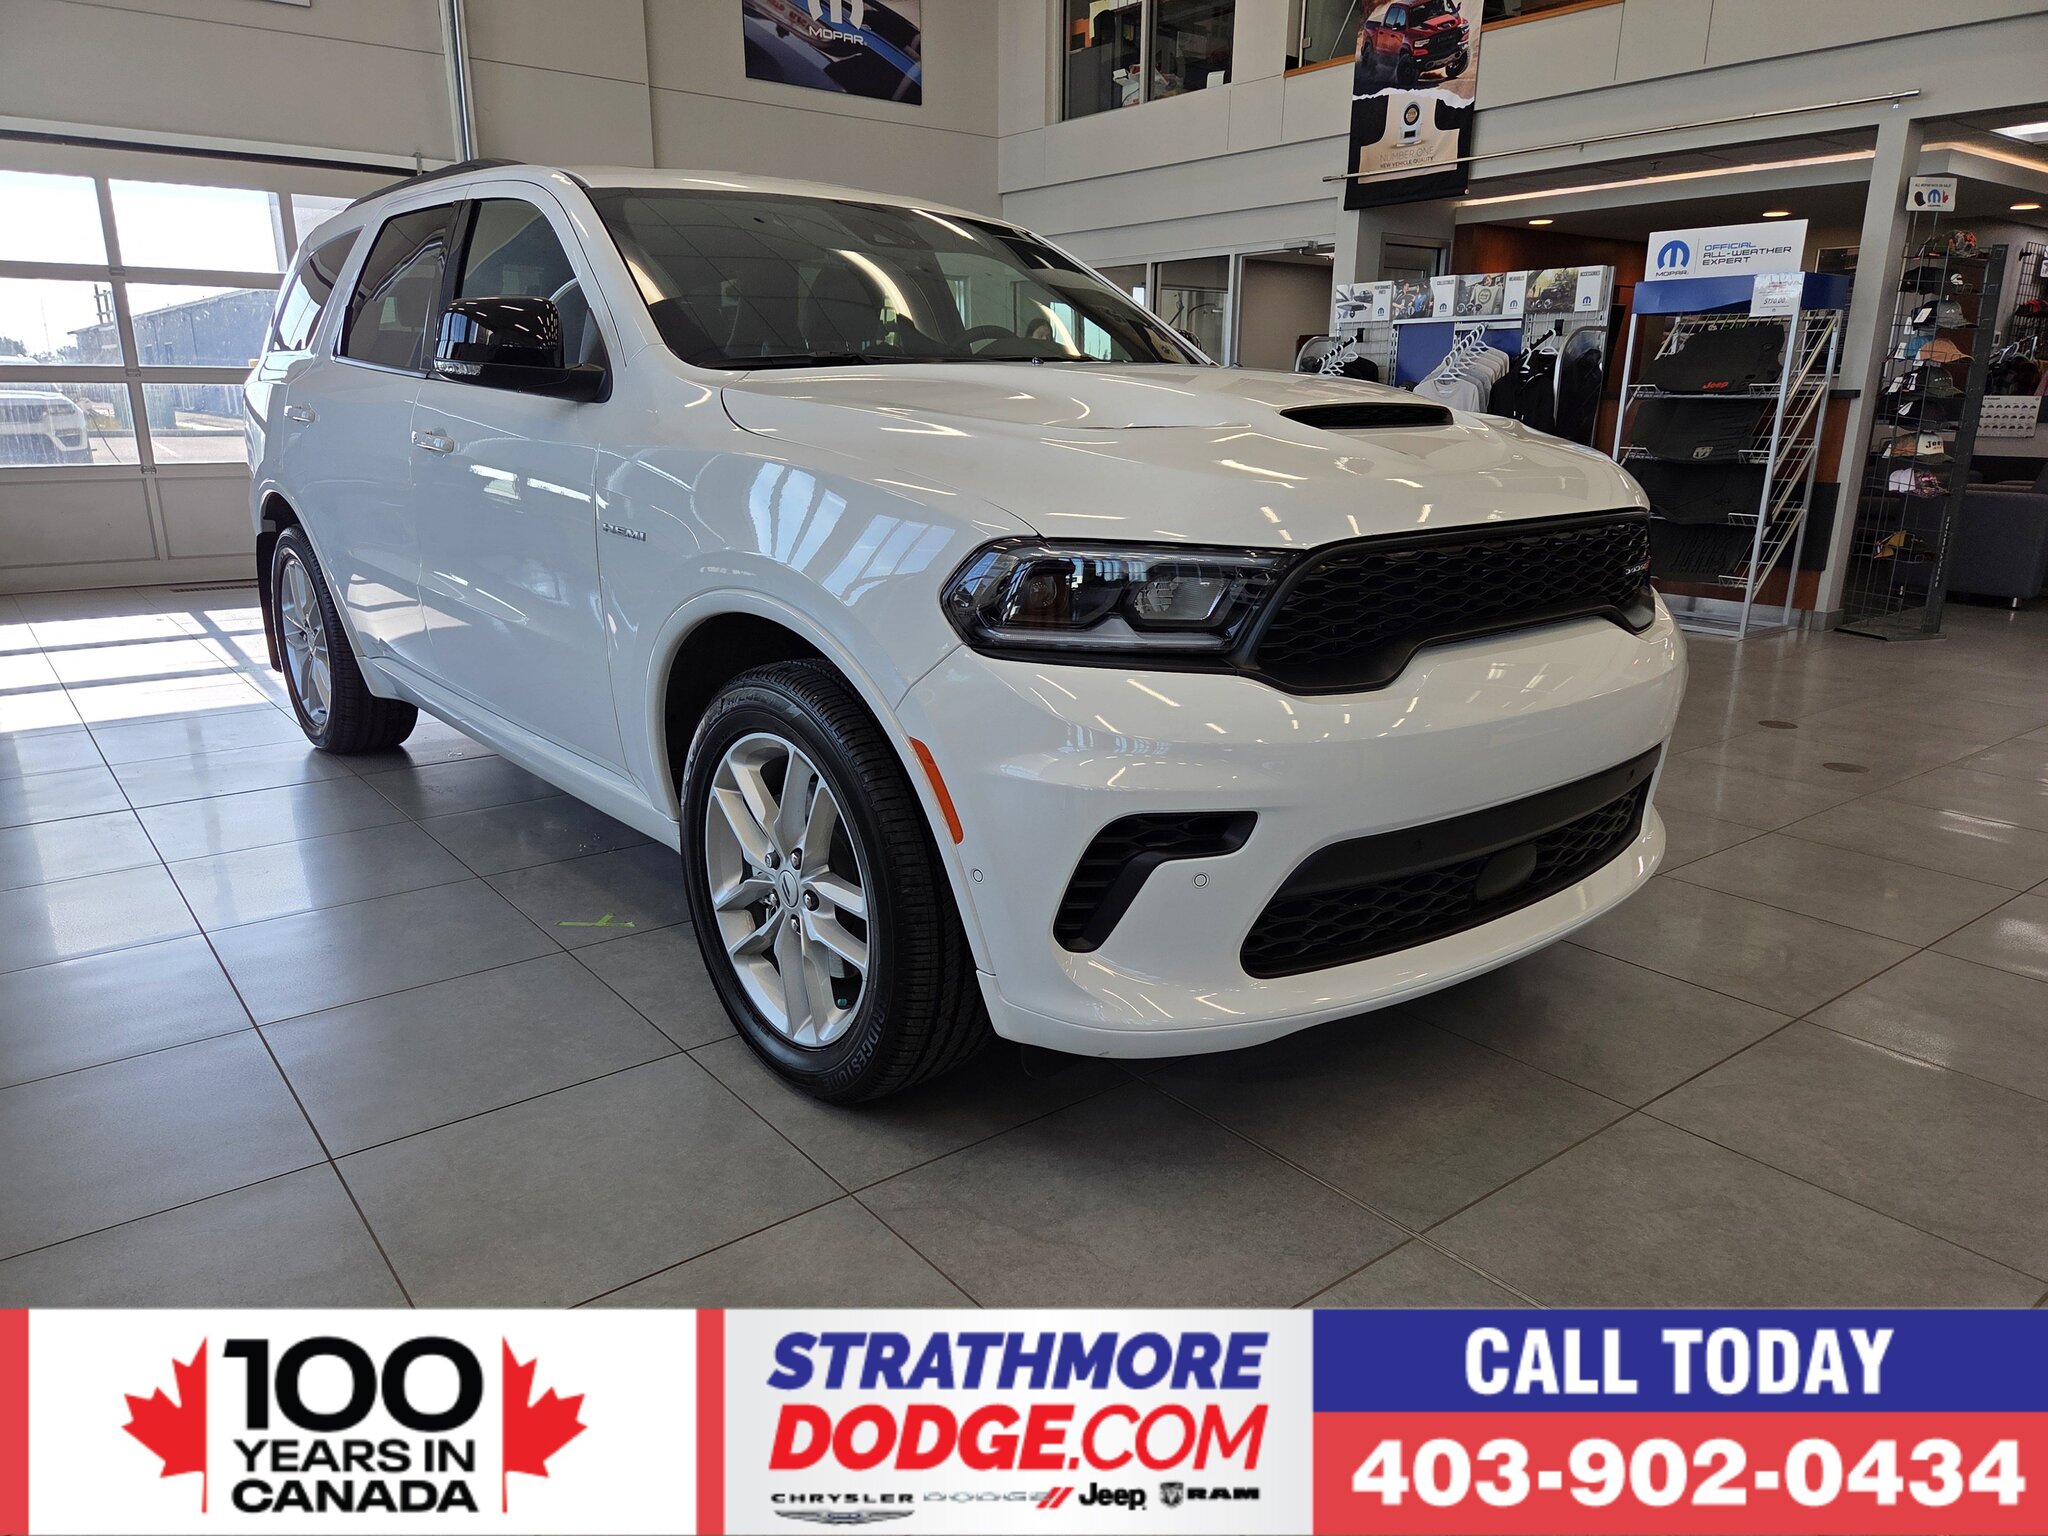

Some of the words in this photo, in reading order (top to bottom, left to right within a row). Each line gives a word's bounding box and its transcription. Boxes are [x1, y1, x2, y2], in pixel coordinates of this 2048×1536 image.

[808, 26, 865, 46] MOPAR
[1379, 150, 1415, 162] NUMBER
[1417, 146, 1435, 157] ONE
[1702, 246, 1792, 258] ALL-WEATHER
[1704, 241, 1757, 251] OFFICIAL
[1702, 256, 1751, 266] EXPERT
[1655, 269, 1688, 277] MOPAR
[602, 523, 647, 541] HEMI
